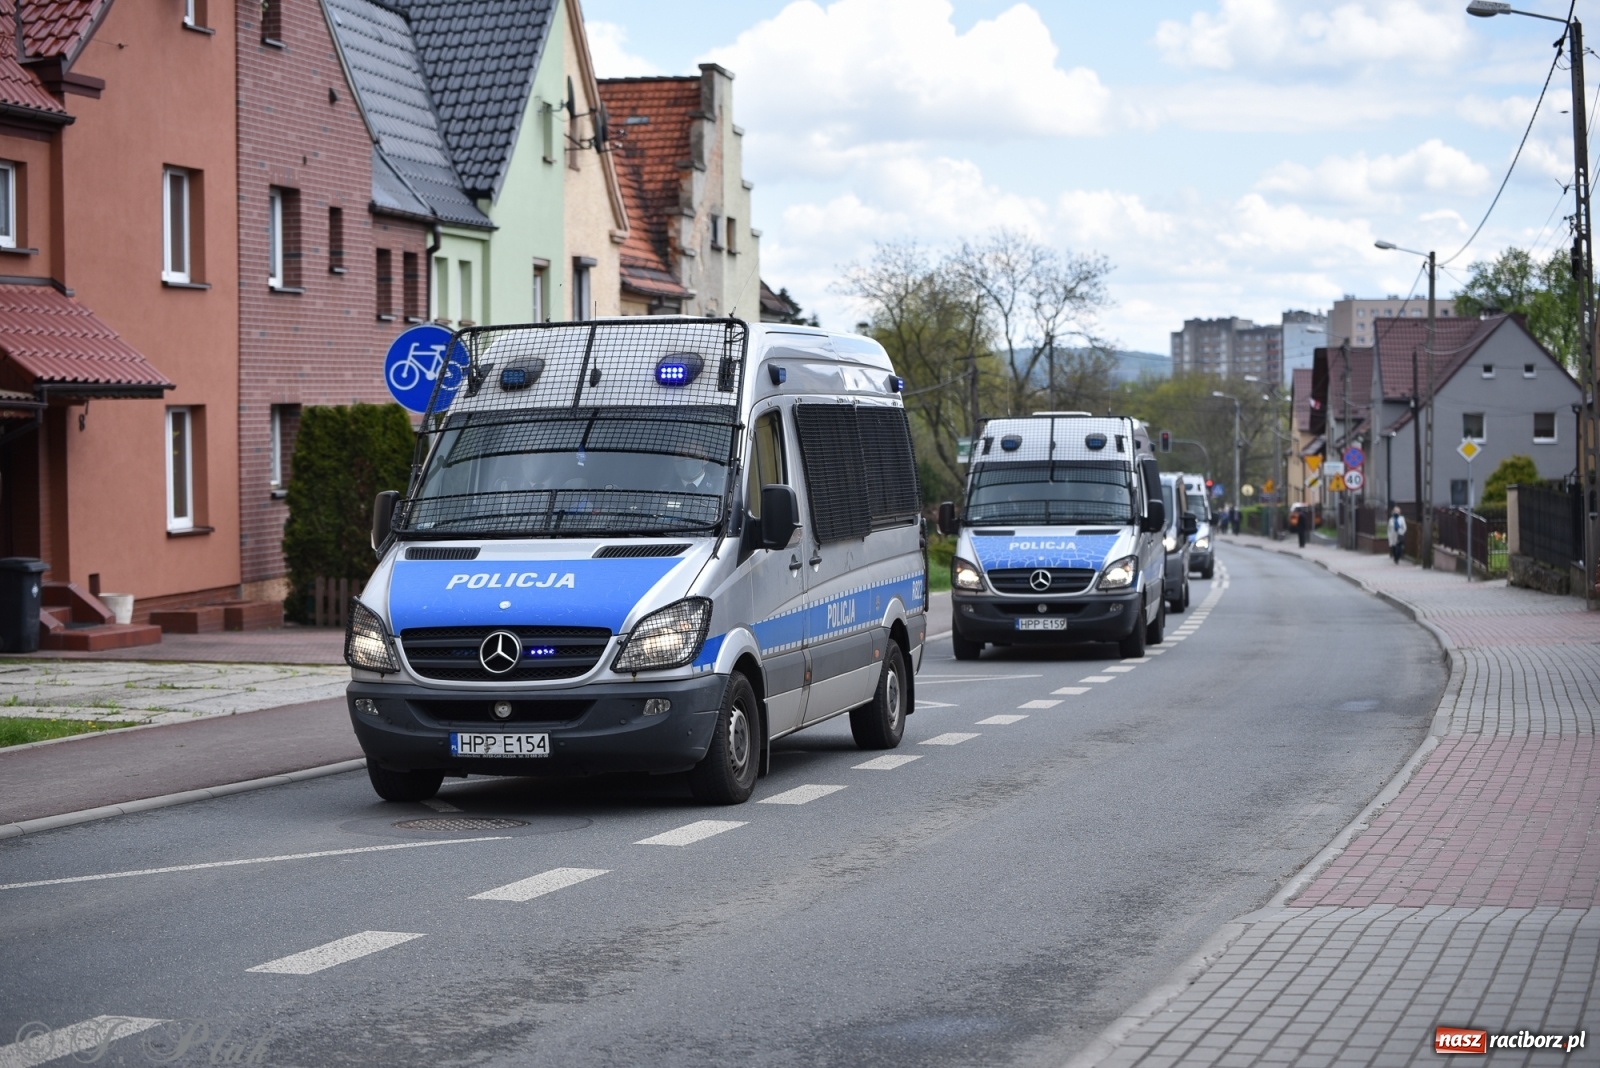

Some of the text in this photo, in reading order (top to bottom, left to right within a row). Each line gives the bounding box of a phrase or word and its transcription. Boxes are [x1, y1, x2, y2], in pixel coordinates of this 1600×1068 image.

[1347, 475, 1361, 485] 40
[1009, 541, 1077, 551] POLICJA
[445, 572, 575, 590] POLICJA
[826, 598, 856, 630] POLICJA
[1020, 619, 1066, 629] HPP E159
[460, 735, 547, 753] HPP E154
